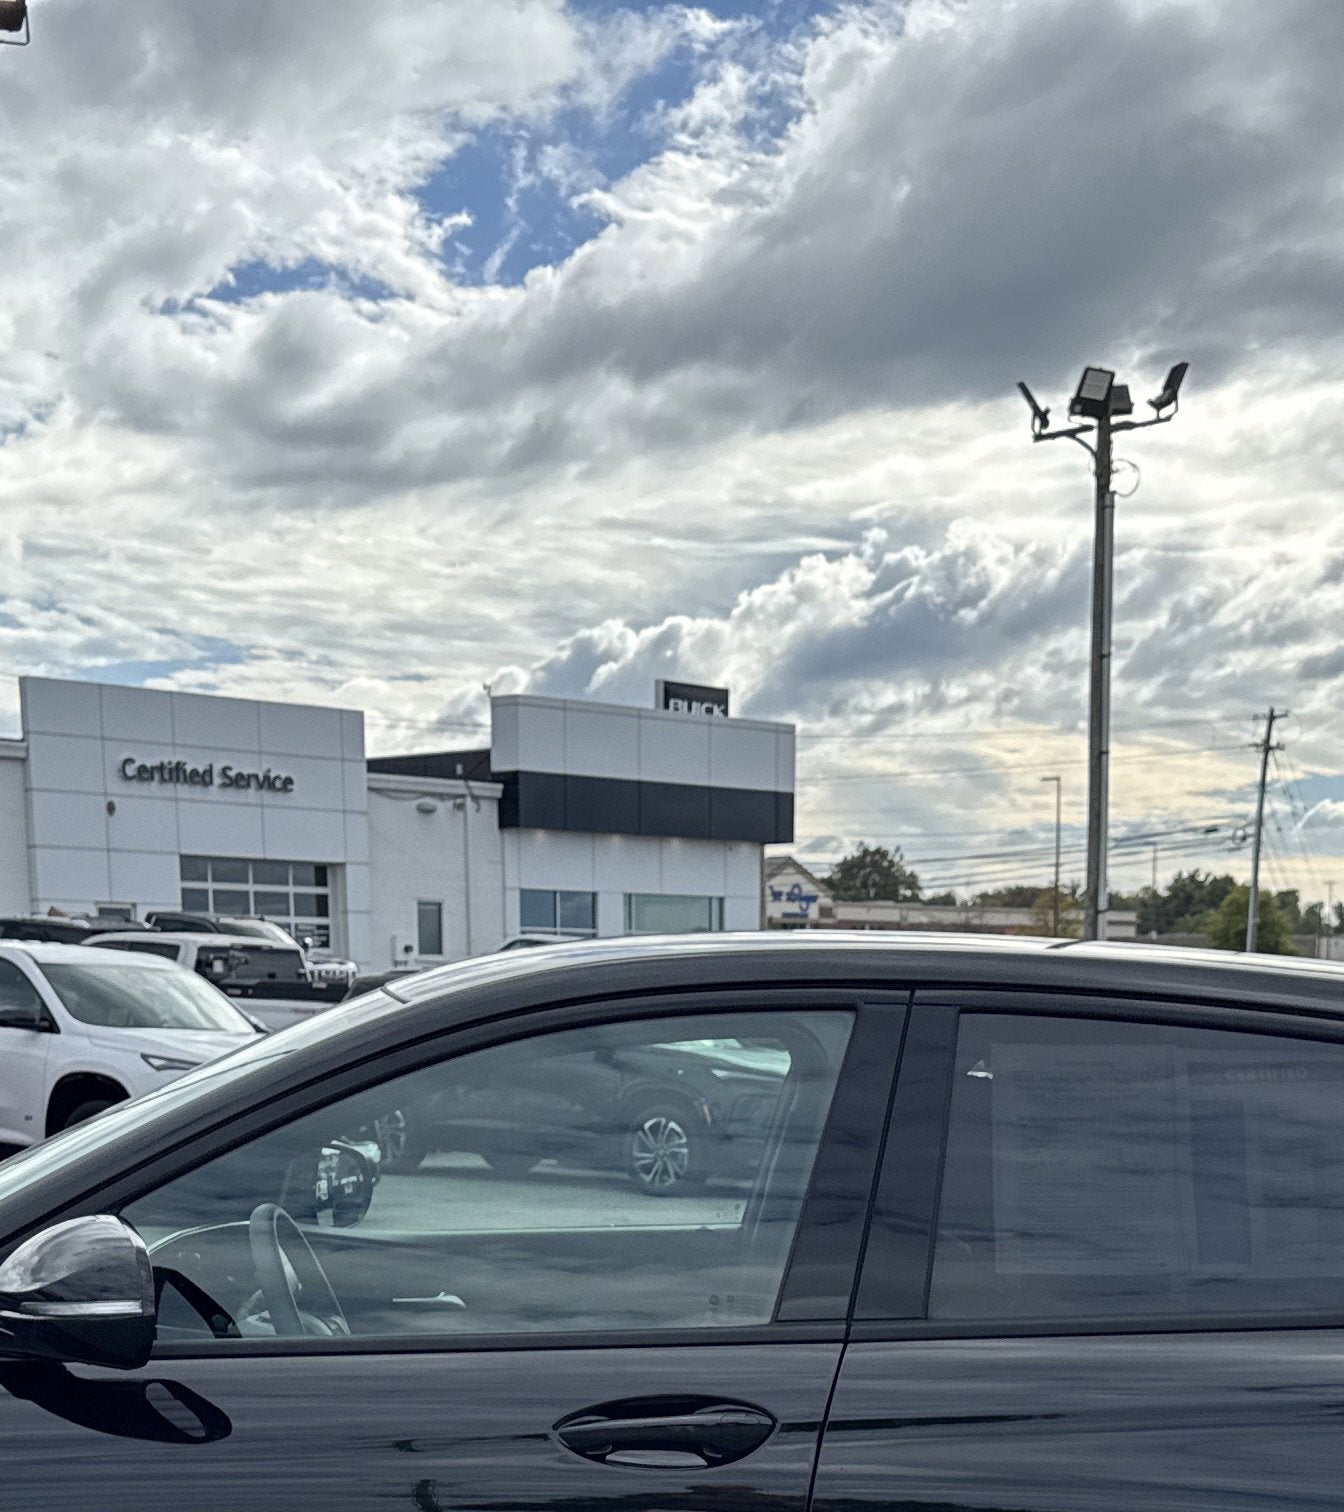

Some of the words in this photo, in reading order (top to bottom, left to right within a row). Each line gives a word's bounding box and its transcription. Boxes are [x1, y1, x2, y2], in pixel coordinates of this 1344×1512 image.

[669, 698, 727, 719] BUICK
[120, 757, 214, 787] Certified
[219, 766, 295, 792] Service
